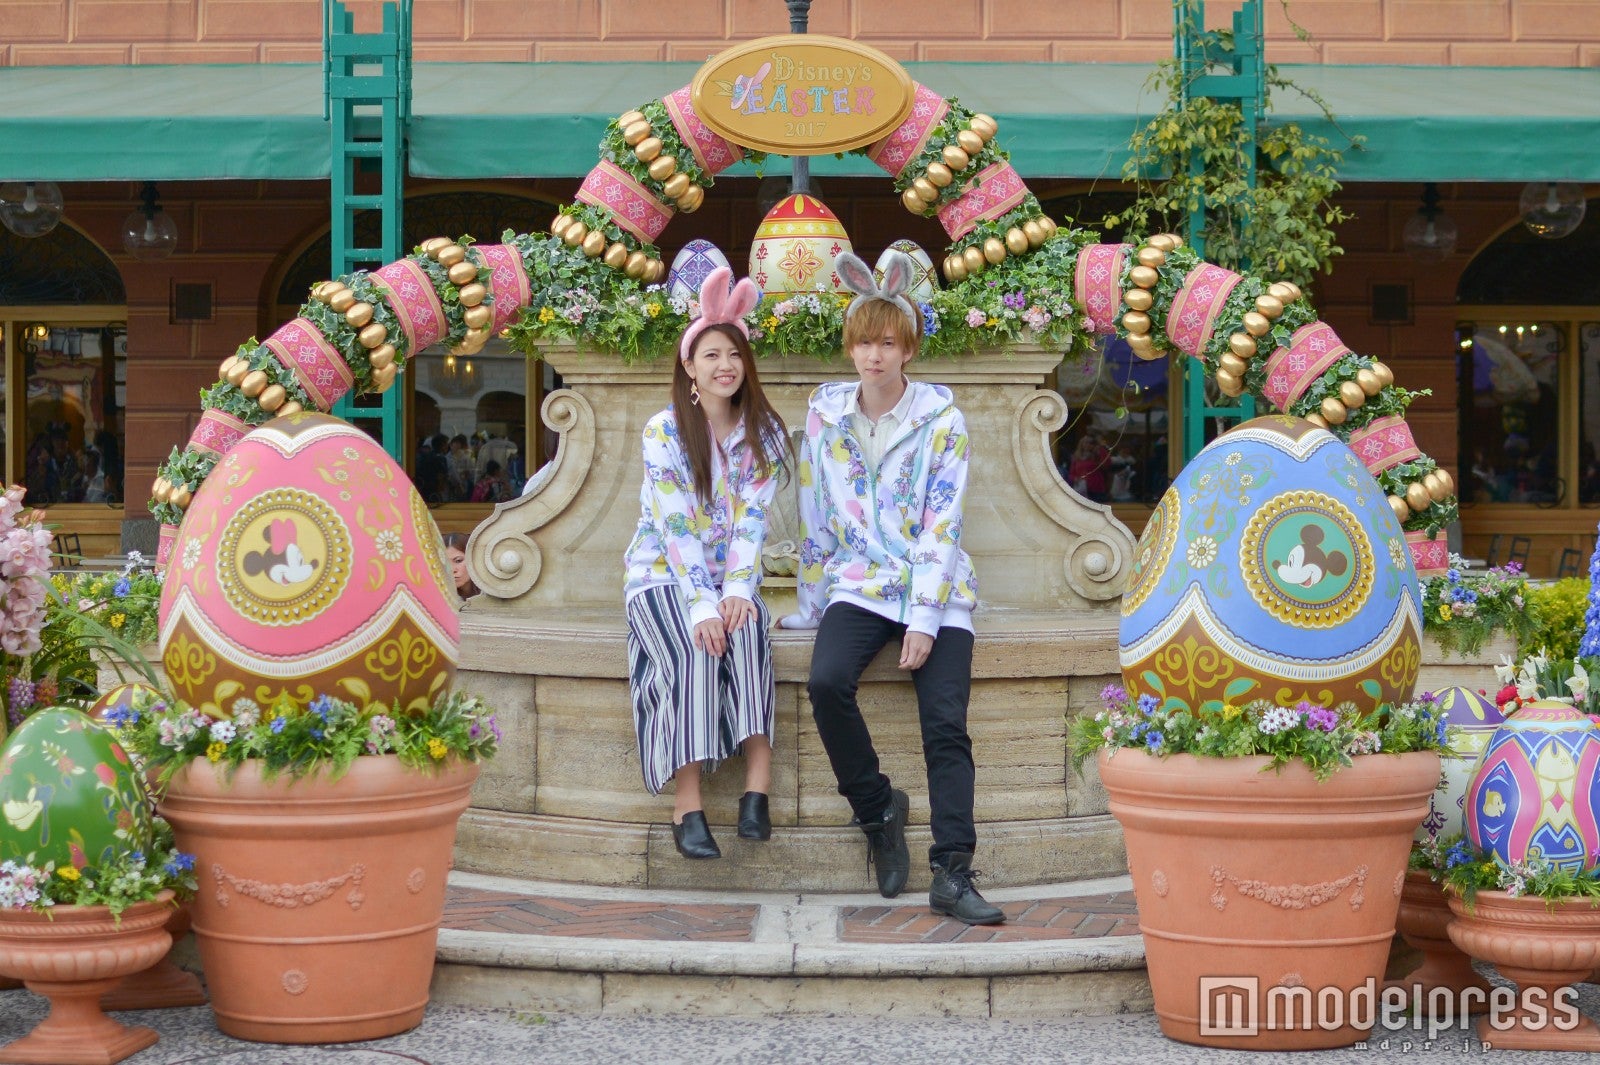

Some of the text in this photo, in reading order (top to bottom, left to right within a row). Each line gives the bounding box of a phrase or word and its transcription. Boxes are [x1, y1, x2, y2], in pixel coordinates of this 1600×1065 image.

[771, 52, 873, 85] Disney's
[740, 83, 877, 117] EASTER
[784, 122, 827, 138] 2017
